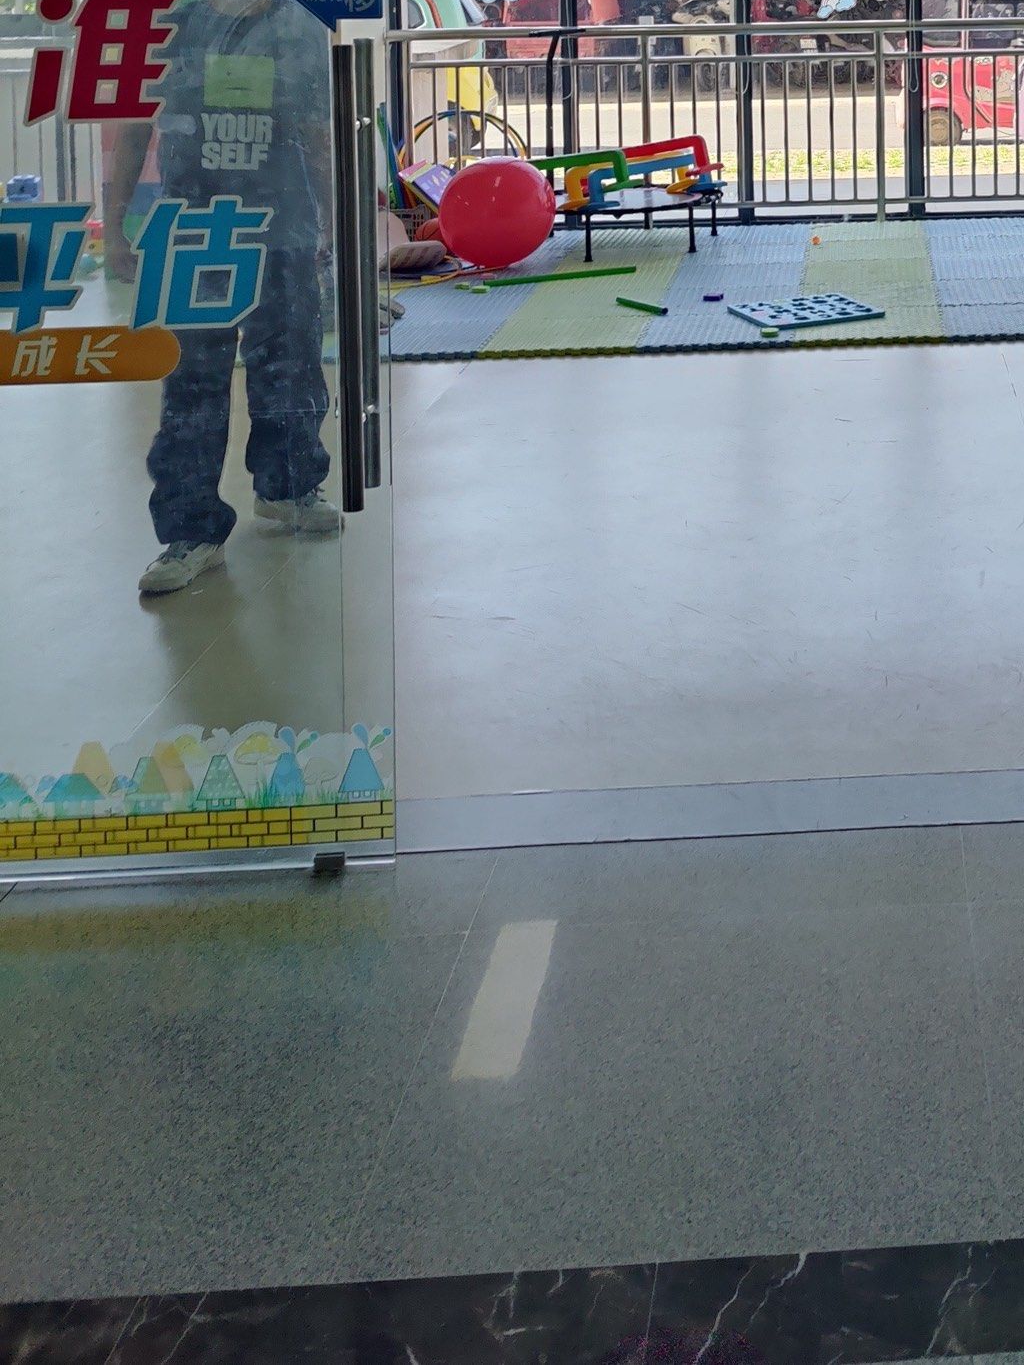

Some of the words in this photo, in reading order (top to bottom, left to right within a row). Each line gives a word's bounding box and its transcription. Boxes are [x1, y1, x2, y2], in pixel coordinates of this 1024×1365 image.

[200, 113, 274, 143] YOUR
[201, 141, 269, 170] SELF
[11, 334, 121, 378] 成长
